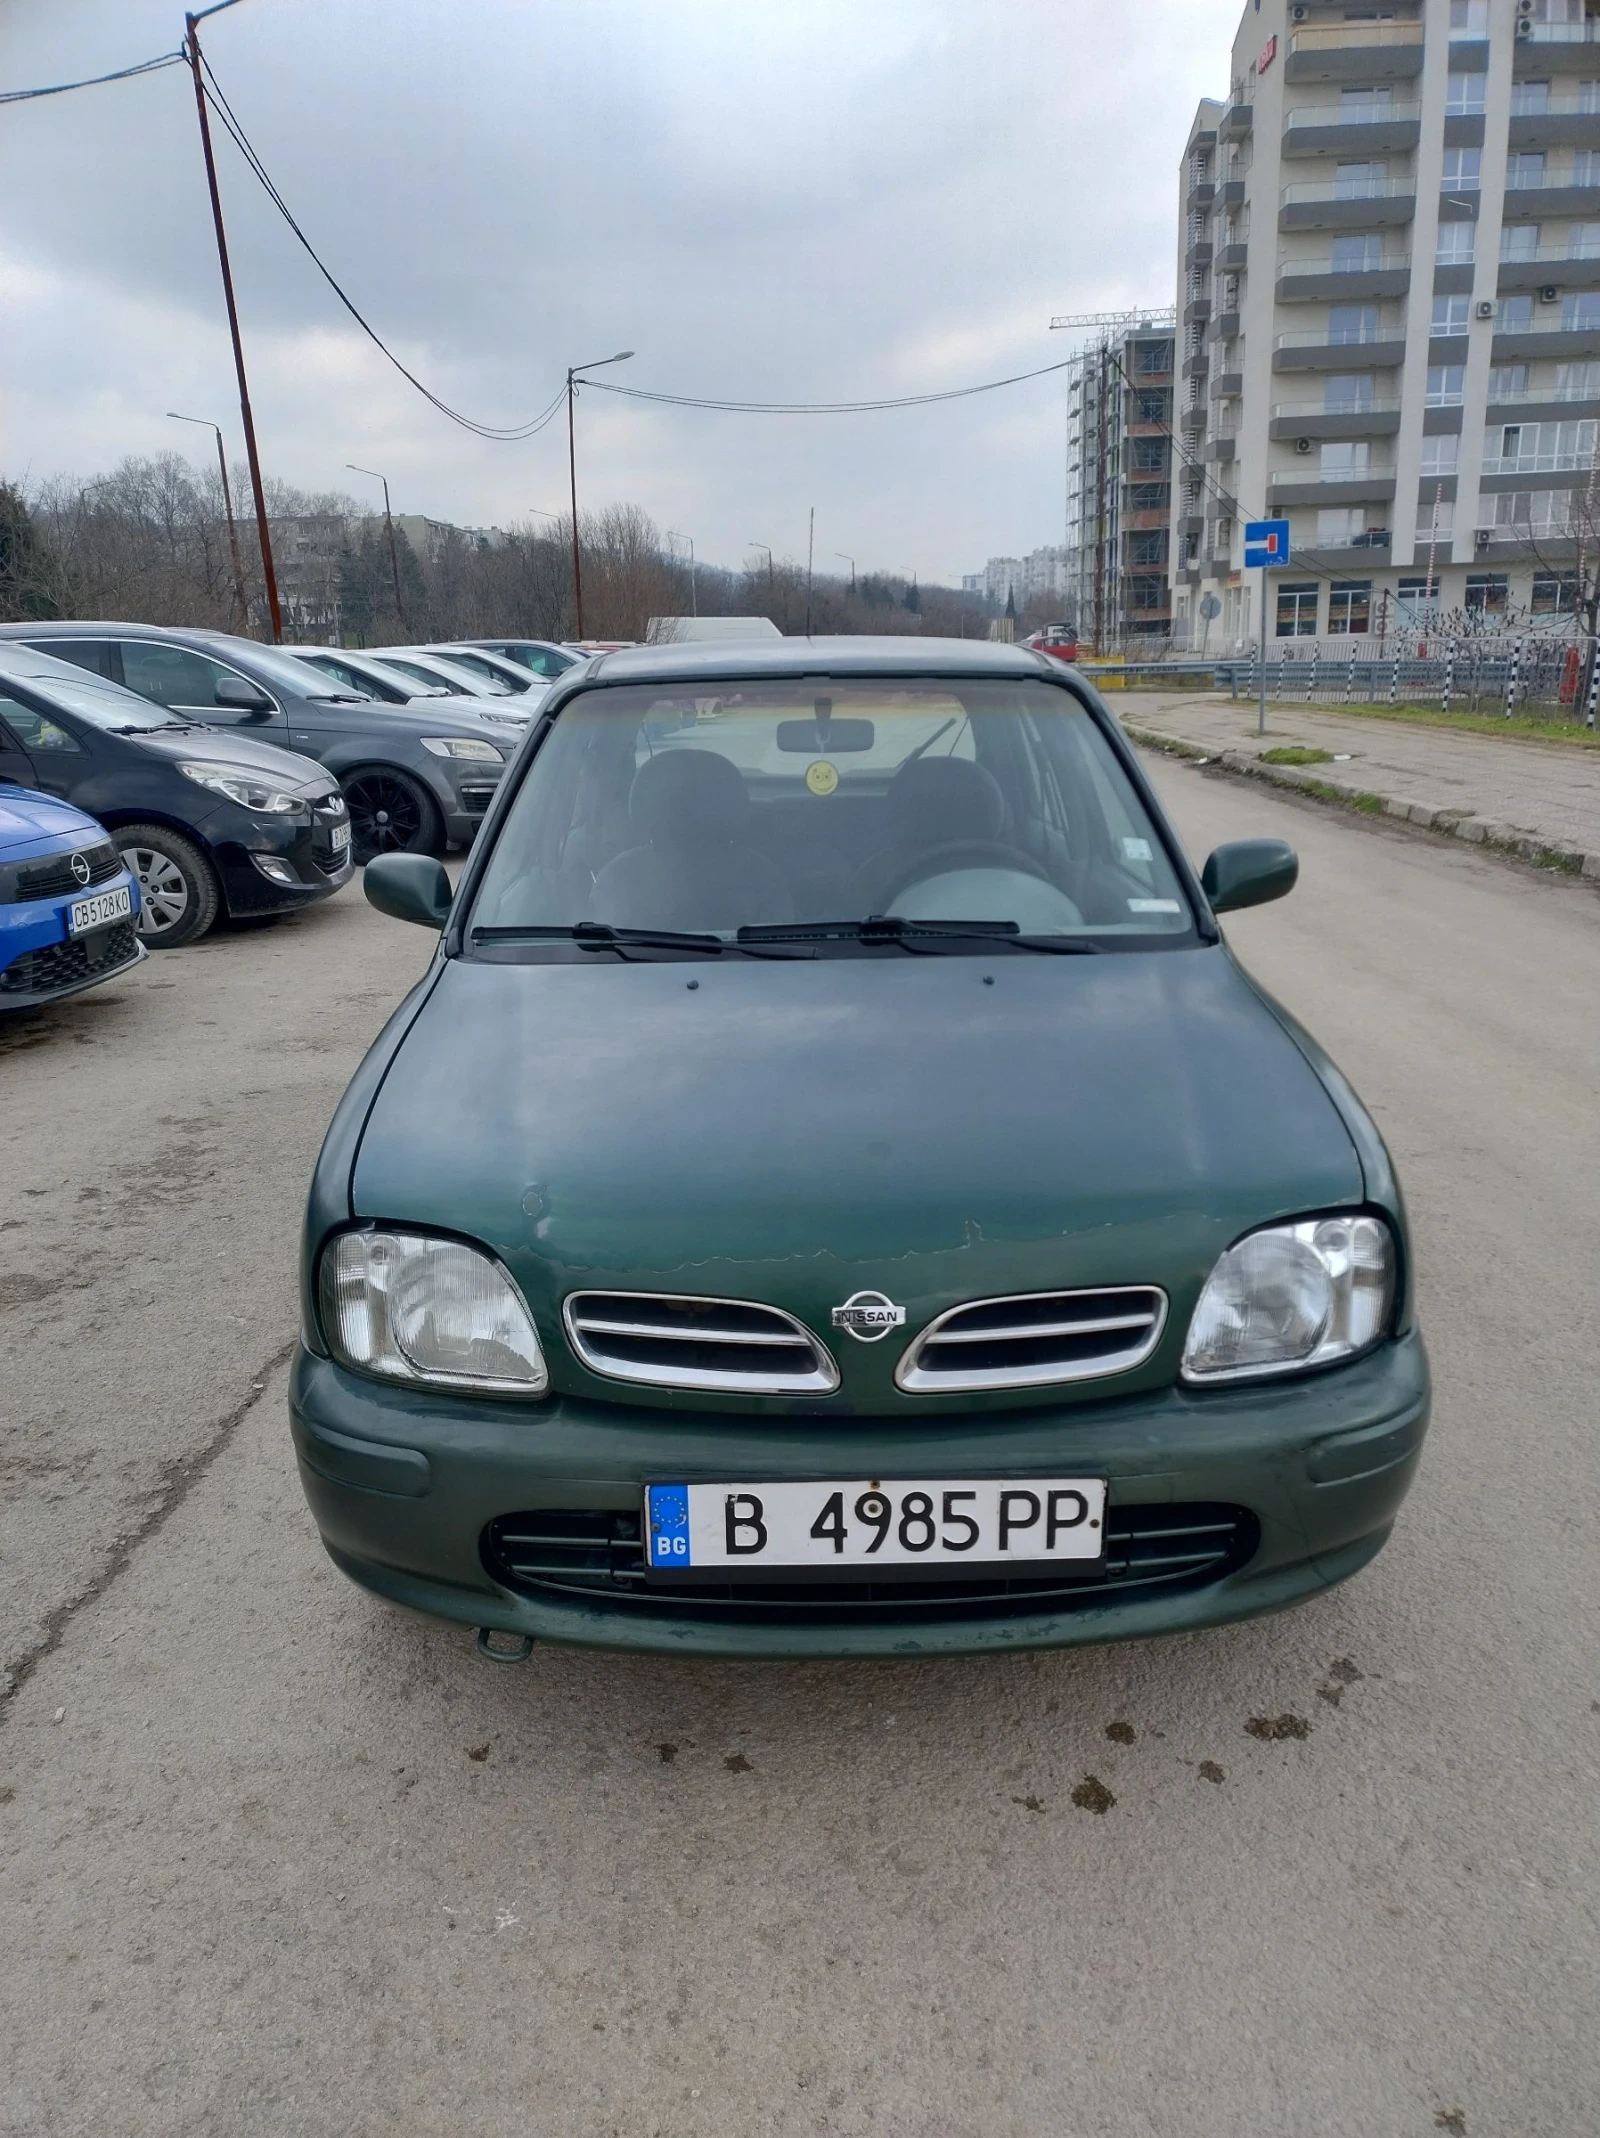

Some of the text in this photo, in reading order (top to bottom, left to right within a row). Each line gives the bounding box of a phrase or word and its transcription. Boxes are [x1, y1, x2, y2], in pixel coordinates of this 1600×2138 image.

[841, 1311, 897, 1322] NISSAN
[724, 1489, 1090, 1555] B 4985 PP
[657, 1536, 687, 1556] BG
